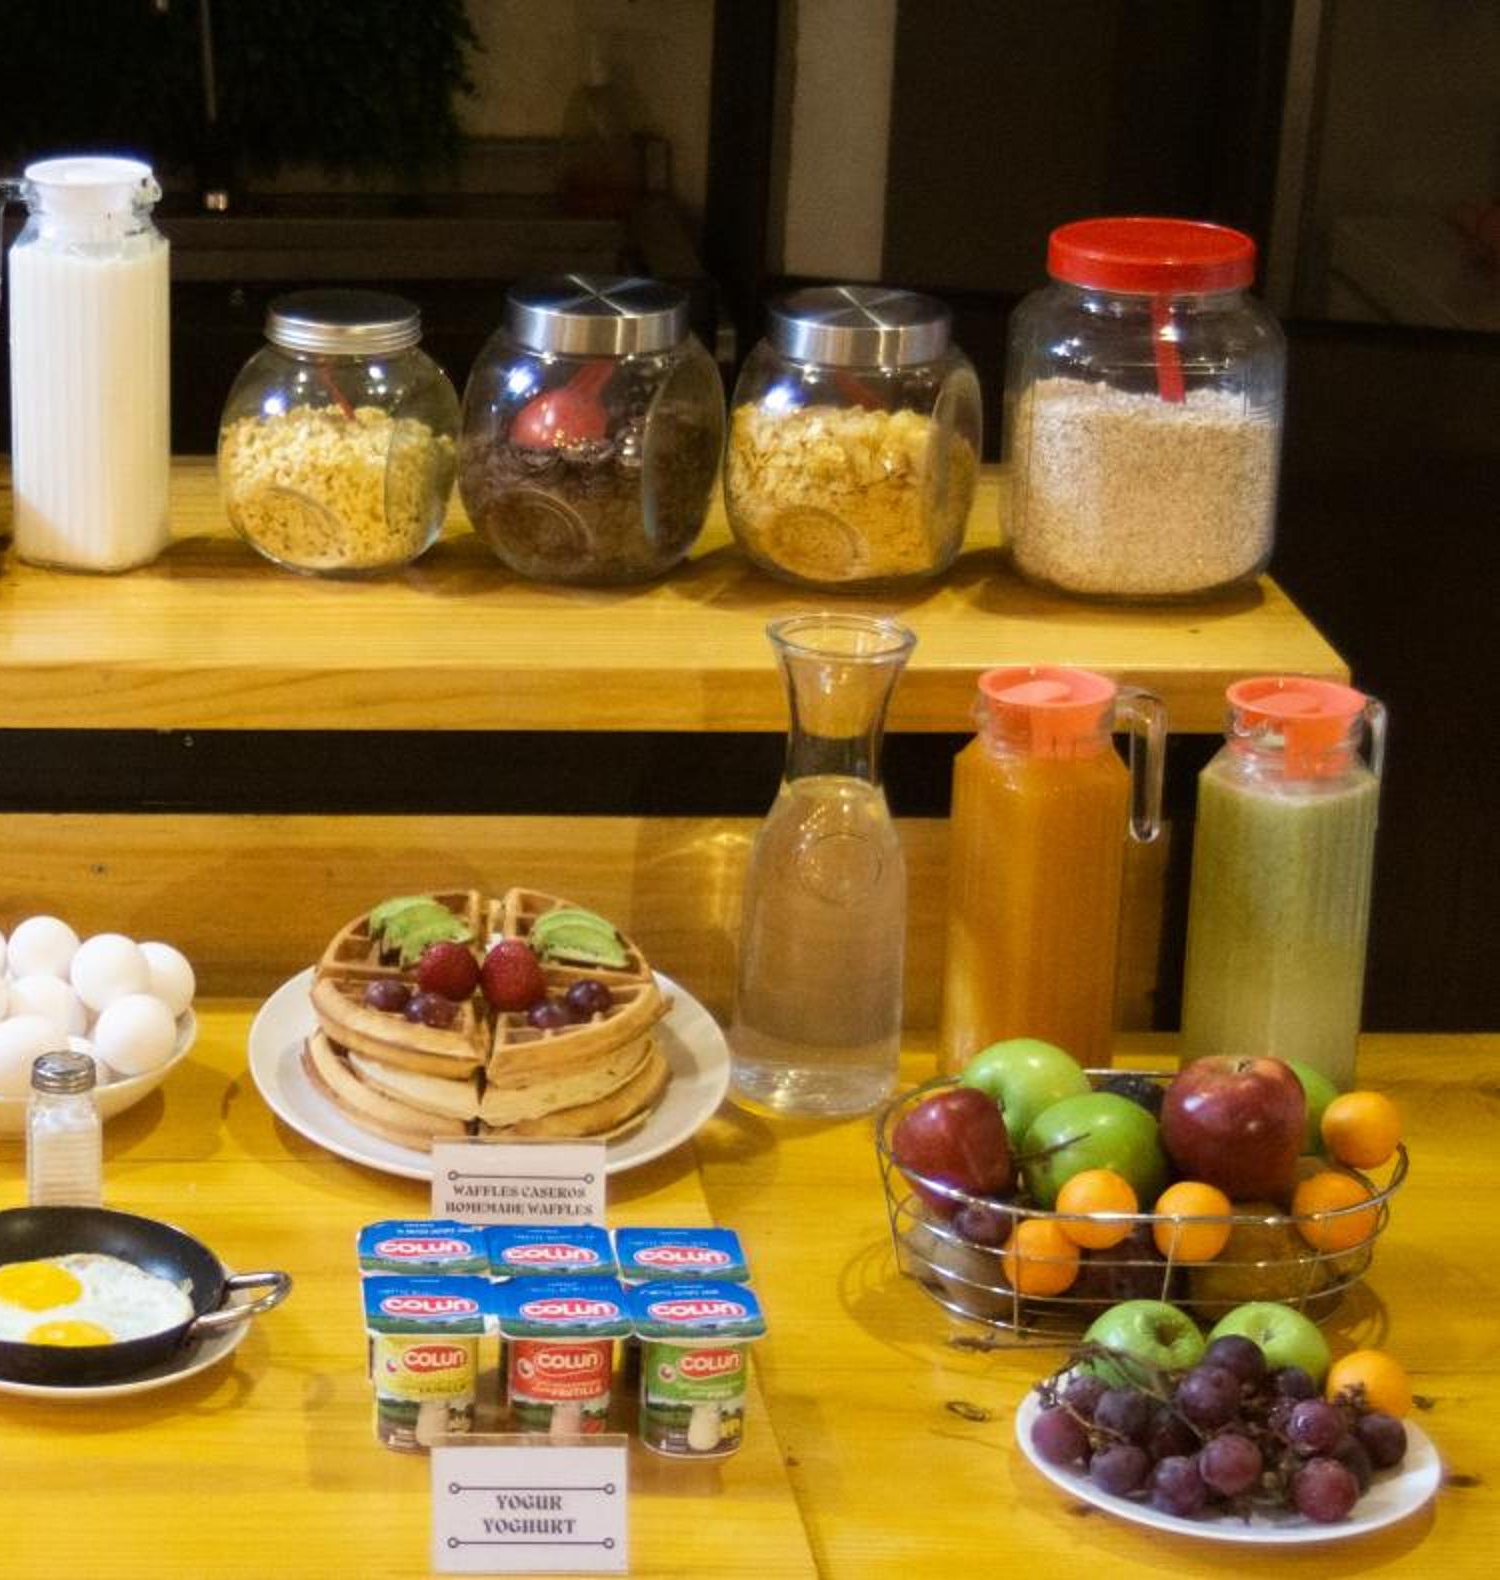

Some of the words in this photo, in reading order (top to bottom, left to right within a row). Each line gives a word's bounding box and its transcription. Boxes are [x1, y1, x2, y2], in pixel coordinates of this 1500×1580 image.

[453, 1184, 518, 1199] WAFFLES
[521, 1185, 587, 1200] CASEROS
[446, 1202, 524, 1216] HOMEMADE
[527, 1203, 594, 1217] WAFFLES
[496, 1495, 562, 1510] YOGUR
[483, 1519, 576, 1534] YOGHURT
